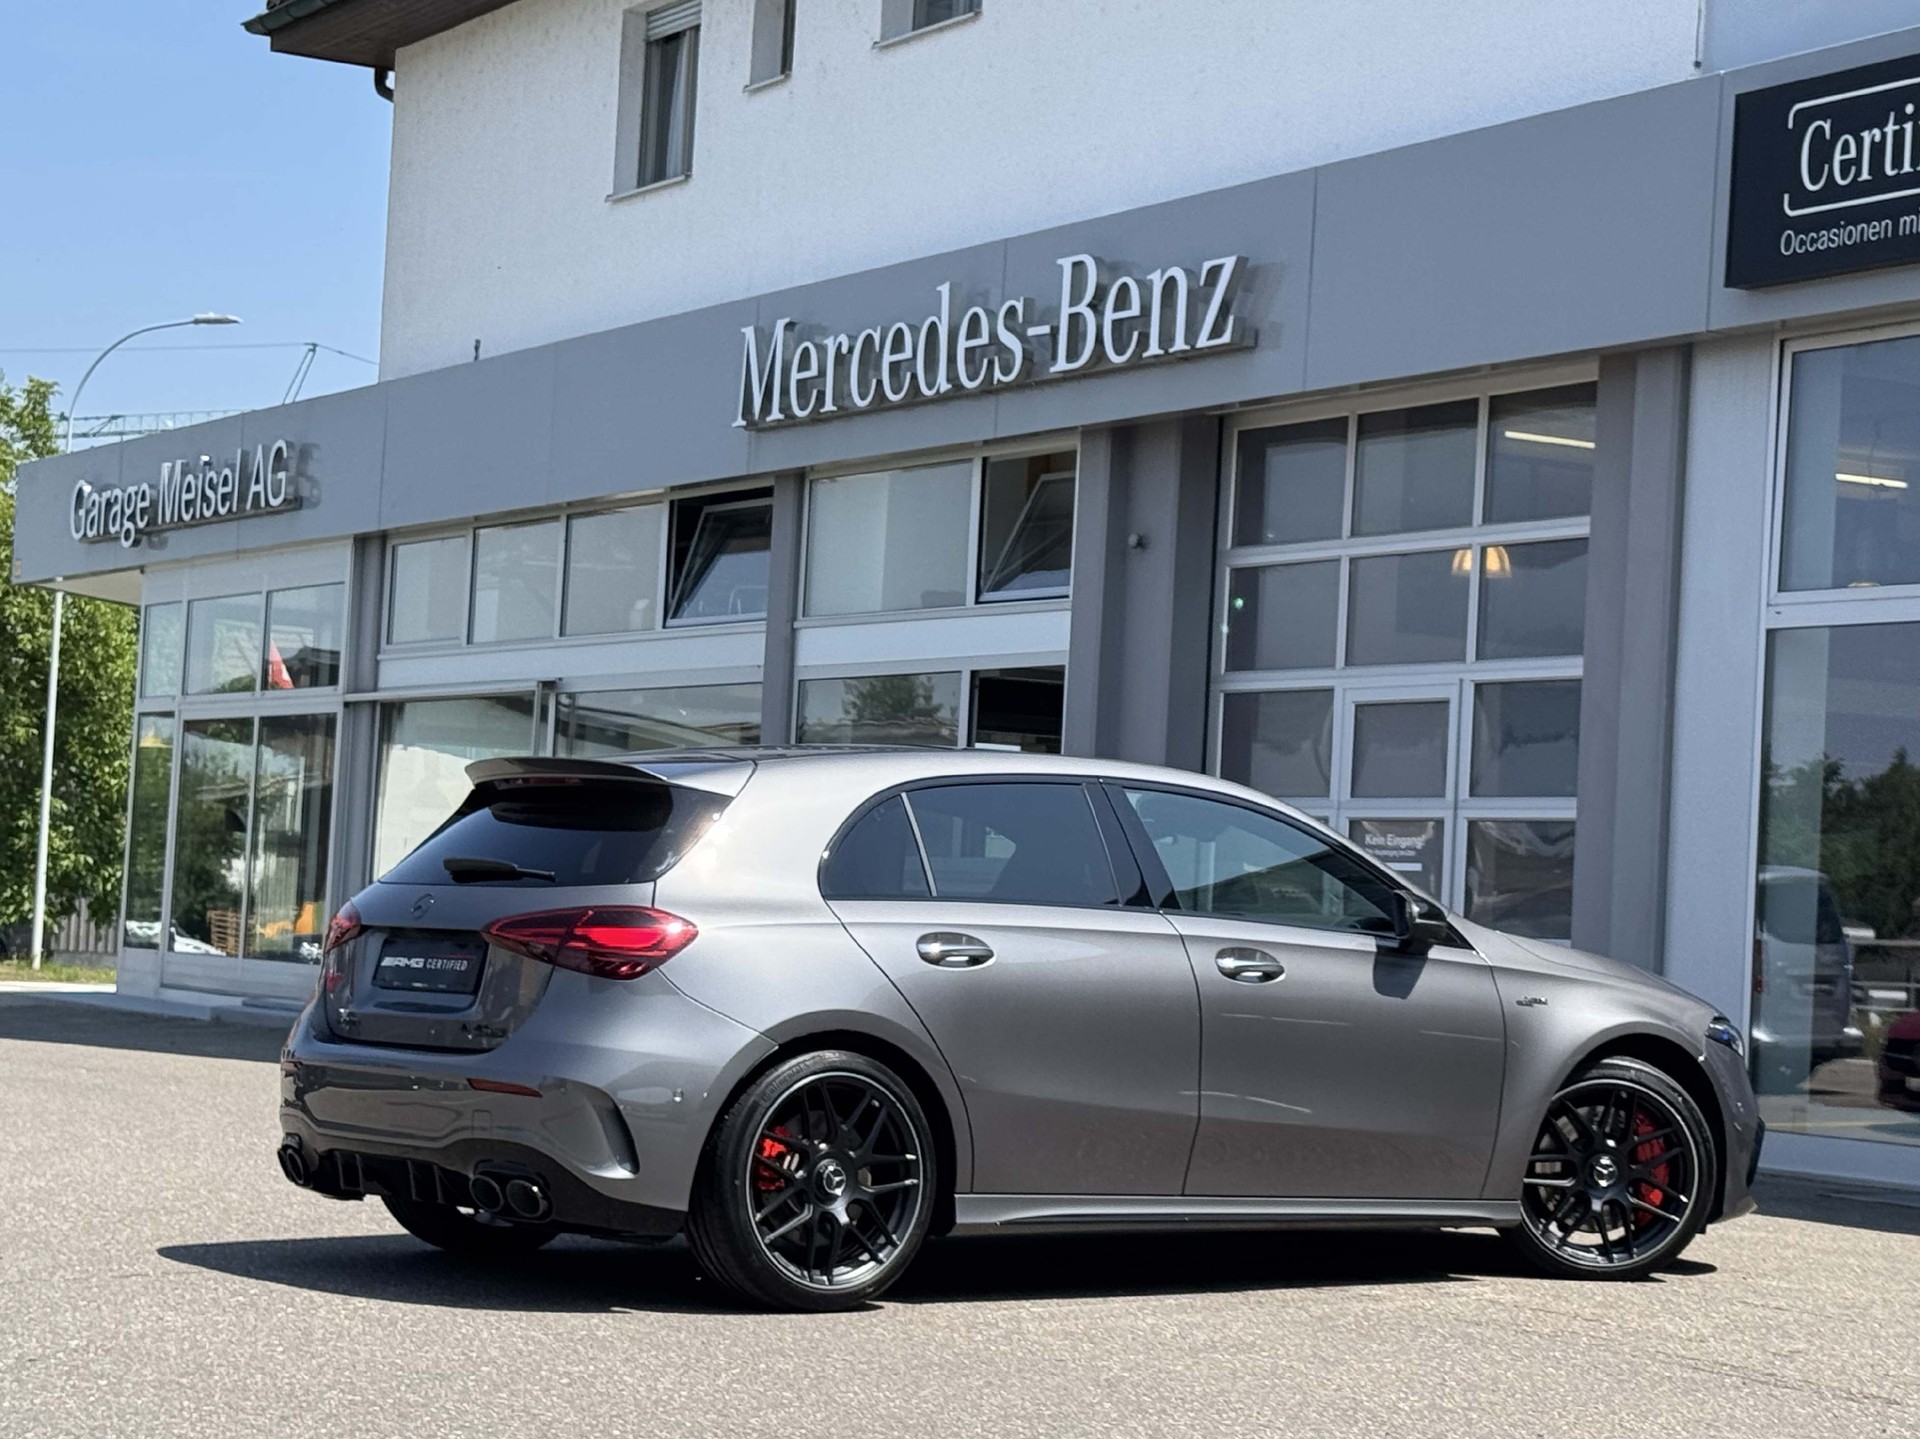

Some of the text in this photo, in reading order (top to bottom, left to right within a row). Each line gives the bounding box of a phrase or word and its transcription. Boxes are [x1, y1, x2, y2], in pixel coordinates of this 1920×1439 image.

[1800, 103, 1920, 191] Certi
[1780, 220, 1892, 256] Occasionen
[731, 253, 1241, 428] Mercedes-Benz
[70, 439, 288, 548] Garage Meisel AG
[387, 956, 468, 971] AMG CERTIFIED
